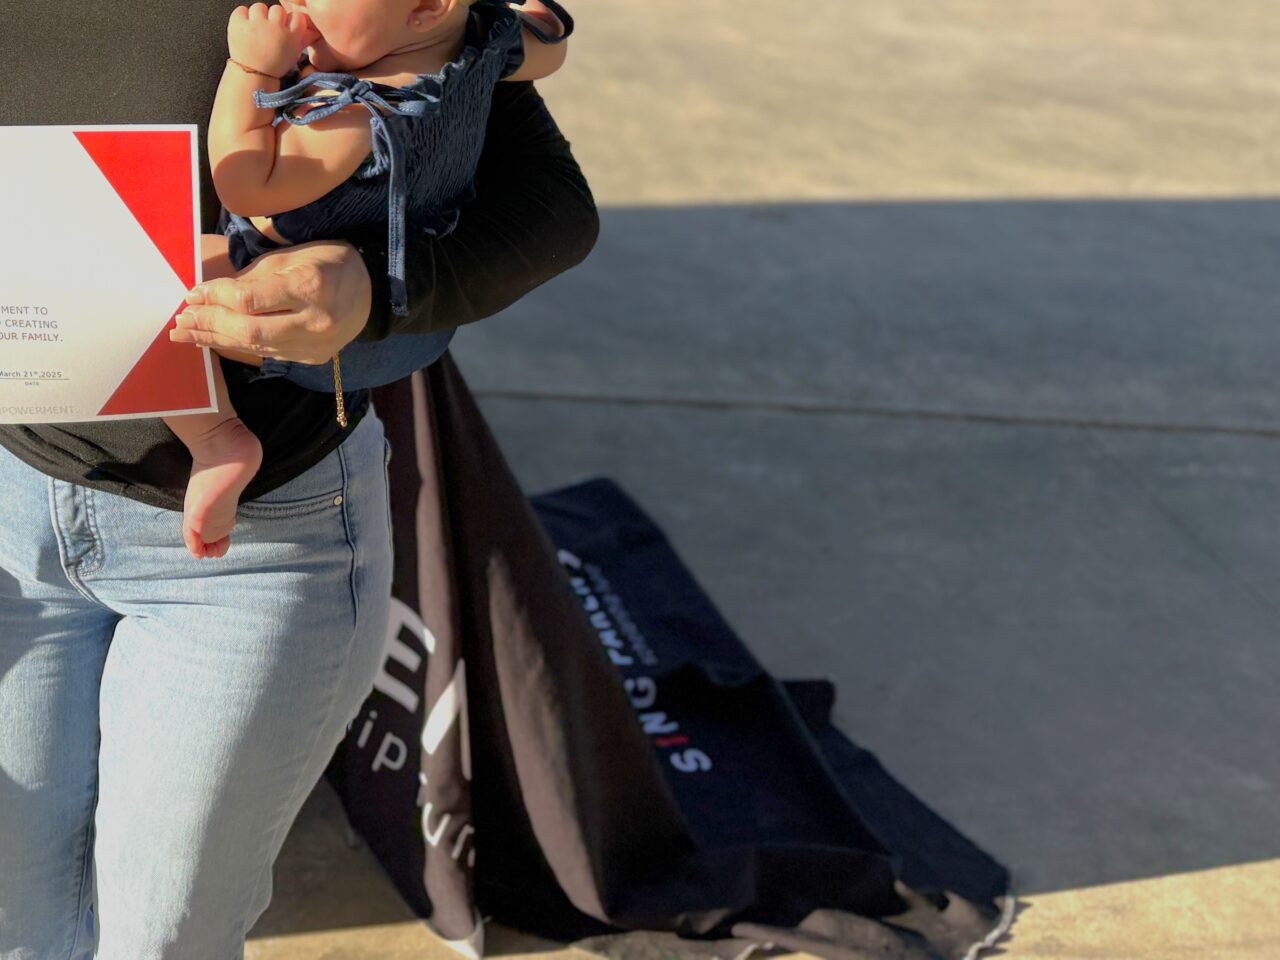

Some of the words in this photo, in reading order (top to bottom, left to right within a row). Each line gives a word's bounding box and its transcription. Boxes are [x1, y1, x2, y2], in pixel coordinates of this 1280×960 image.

[33, 306, 48, 316] TO
[4, 319, 58, 329] CREATING
[21, 332, 64, 342] FAMILY.
